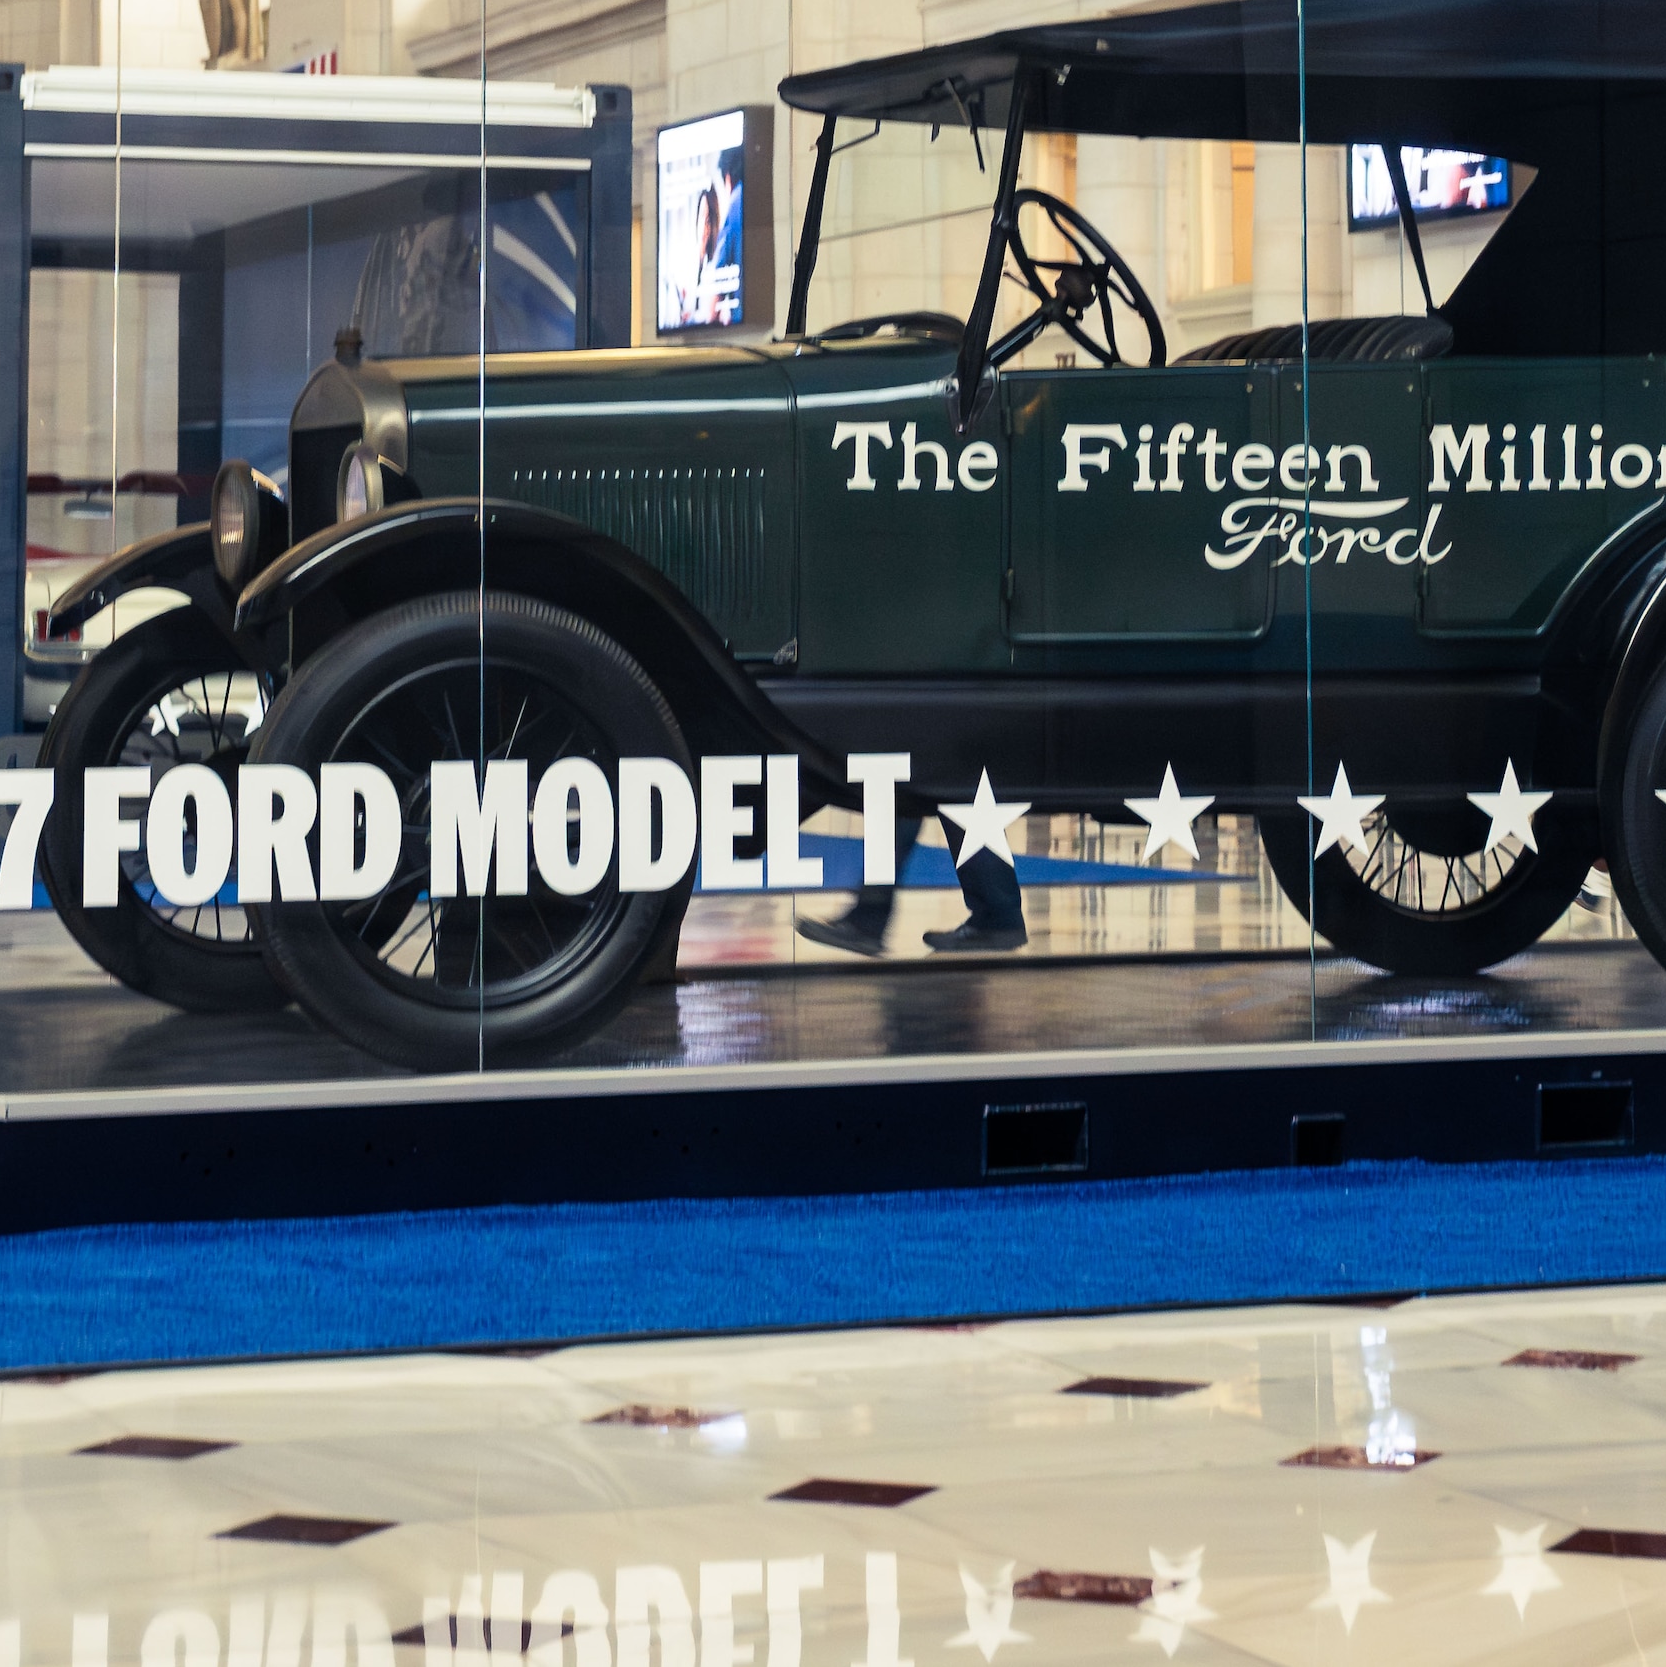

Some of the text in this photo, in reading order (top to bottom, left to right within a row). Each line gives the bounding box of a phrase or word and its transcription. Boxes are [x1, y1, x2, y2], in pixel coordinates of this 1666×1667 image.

[831, 421, 999, 491] The
[1057, 422, 1380, 492] Fifteen
[1203, 497, 1453, 571] Ford
[82, 763, 403, 908] FORD
[429, 754, 824, 897] MODEL
[847, 752, 911, 885] T
